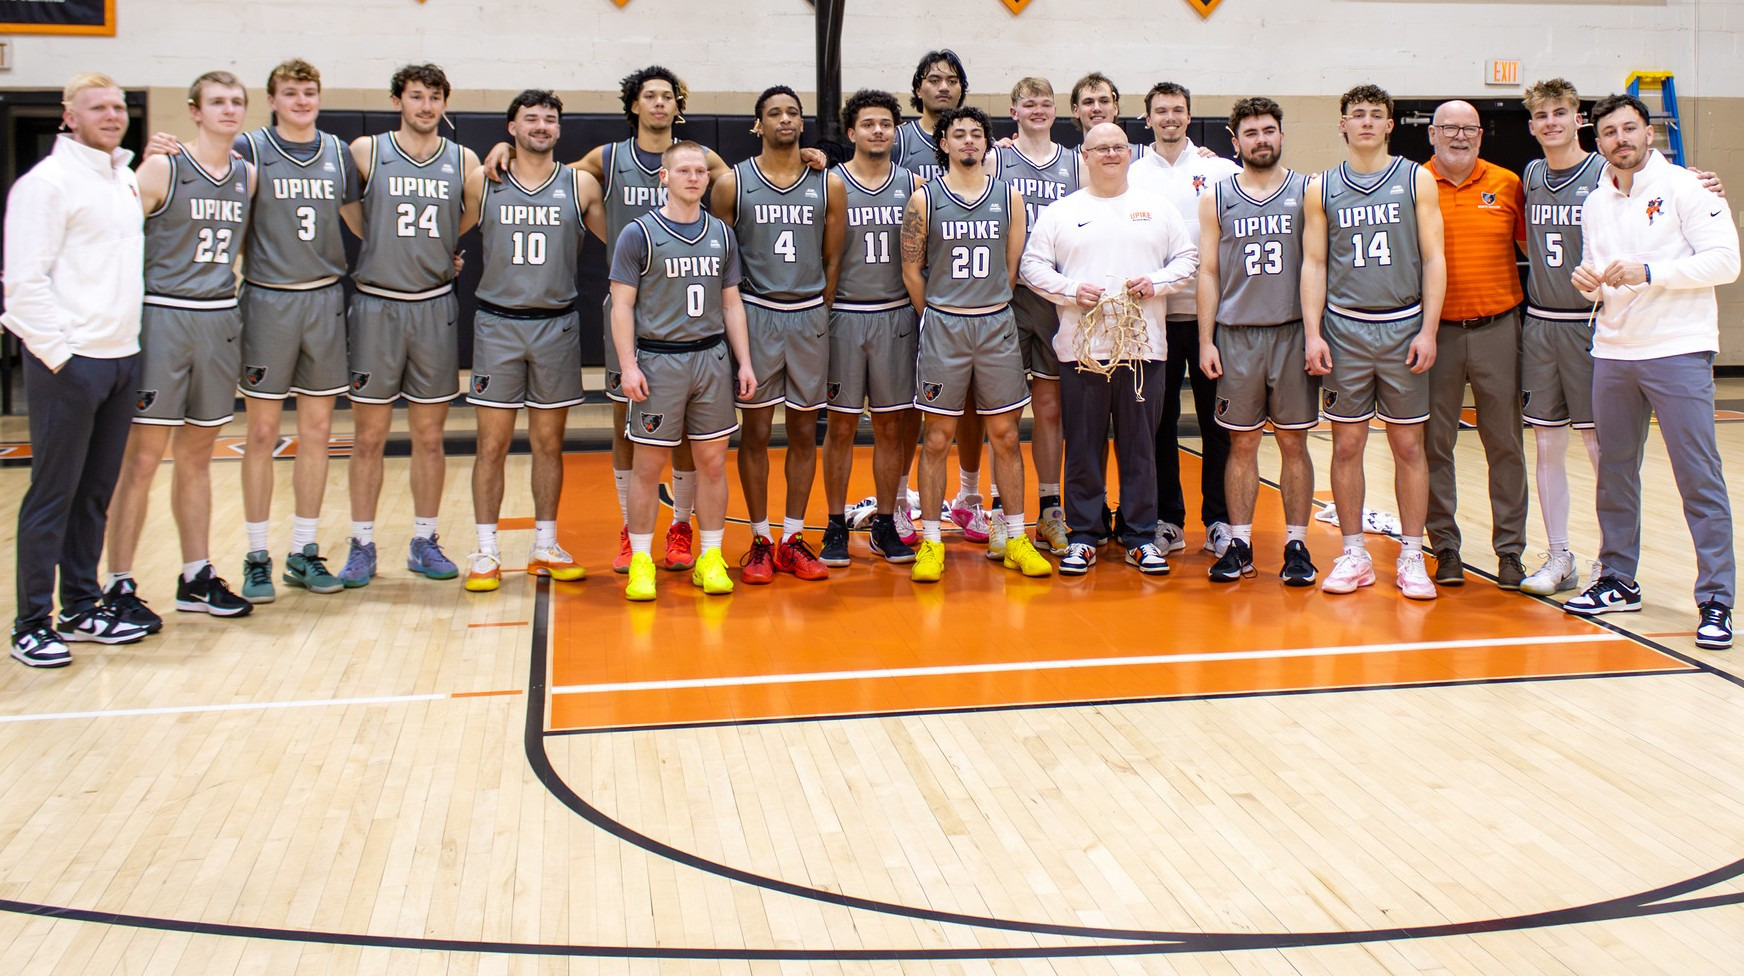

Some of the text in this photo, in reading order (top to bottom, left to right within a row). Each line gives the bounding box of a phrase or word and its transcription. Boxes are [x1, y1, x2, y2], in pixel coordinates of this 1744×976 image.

[1493, 61, 1519, 82] EXIT
[273, 178, 335, 200] UPIKE
[388, 176, 449, 200] UPIKE
[624, 186, 668, 206] UPIK
[1013, 178, 1066, 199] UPIKE
[190, 198, 242, 223] UPIKE
[397, 203, 440, 238] 24
[500, 205, 561, 226] UPIKE
[754, 204, 814, 225] UPIKE
[847, 206, 903, 226] UPIKE
[1337, 202, 1400, 228] UPIKE
[1530, 204, 1583, 226] UPIKE
[297, 206, 315, 241] 3
[941, 220, 1000, 240] UPIKE
[1233, 214, 1292, 238] UPIKE
[195, 228, 232, 264] 22
[512, 232, 546, 265] 10
[774, 230, 796, 262] 4
[865, 231, 890, 263] 11
[1244, 241, 1282, 276] 23
[1352, 231, 1391, 267] 14
[1546, 233, 1563, 267] 5
[664, 256, 720, 278] UPIKE
[952, 246, 990, 279] 20
[687, 284, 705, 317] 0
